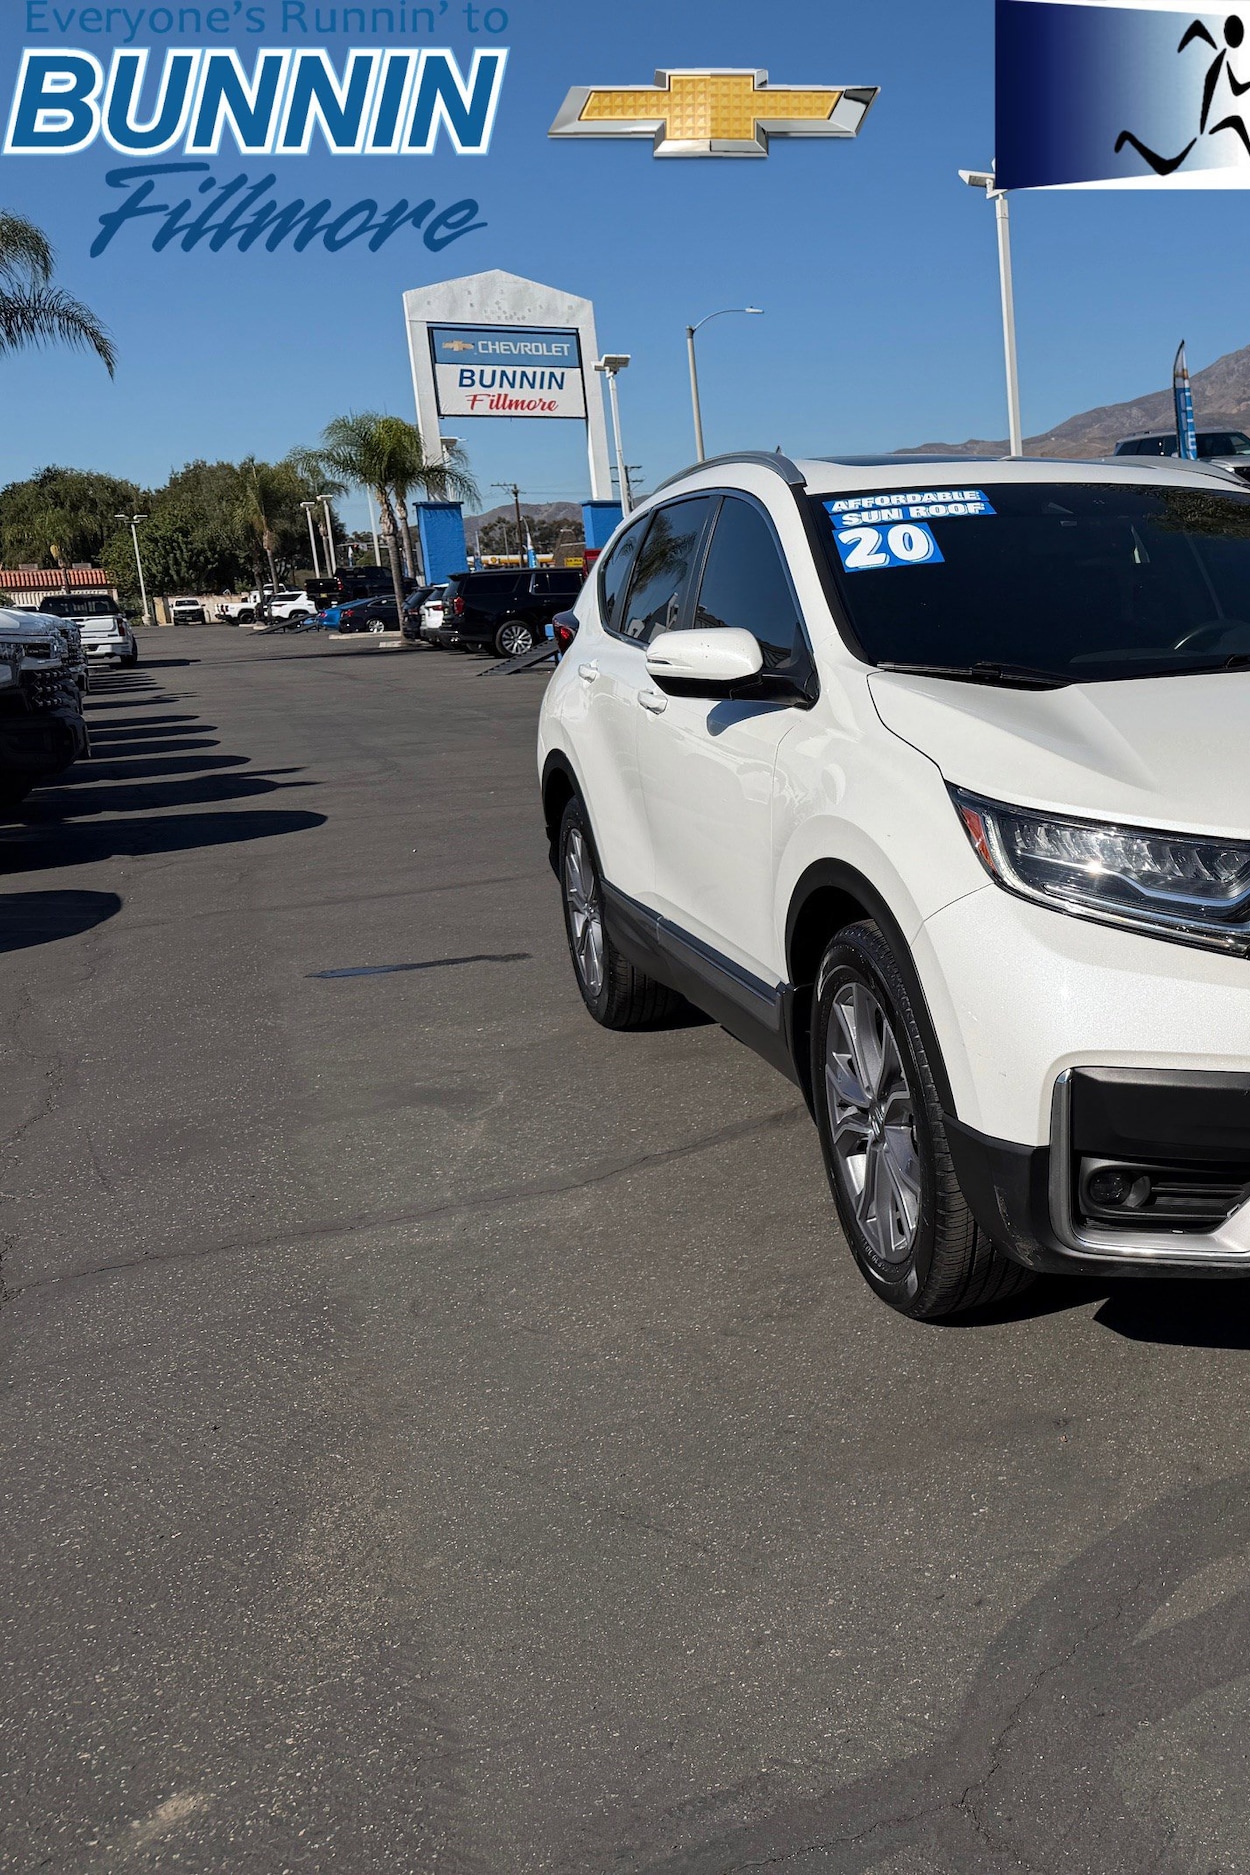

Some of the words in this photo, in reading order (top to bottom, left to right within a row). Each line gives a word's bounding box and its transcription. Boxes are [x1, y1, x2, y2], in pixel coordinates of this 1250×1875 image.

[478, 340, 571, 356] CHEVROLET
[458, 368, 566, 391] BUNNIN
[465, 393, 559, 412] Fillmore
[831, 490, 982, 513] AFFORDABLE
[842, 508, 904, 527] SUN
[909, 502, 986, 519] ROOF
[838, 523, 935, 569] 20
